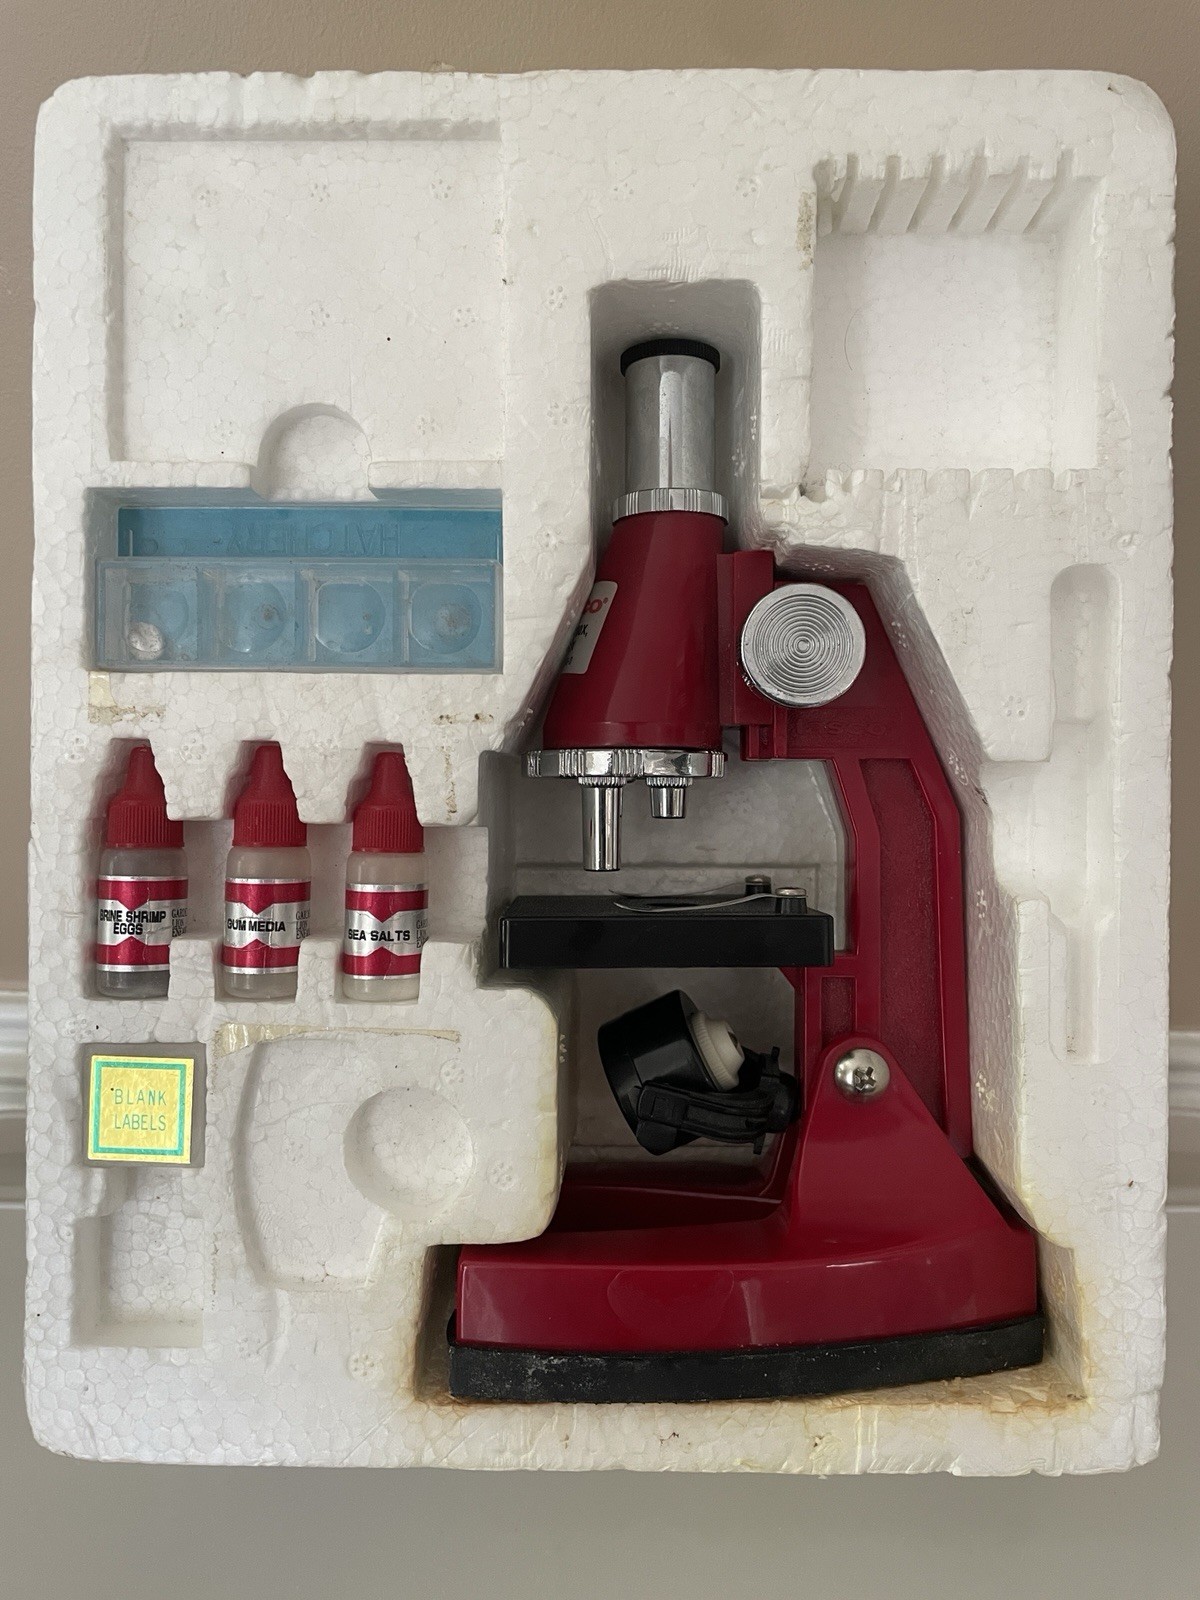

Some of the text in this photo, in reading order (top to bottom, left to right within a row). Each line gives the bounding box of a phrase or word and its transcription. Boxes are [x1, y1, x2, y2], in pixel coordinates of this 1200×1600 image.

[100, 909, 166, 923] BRINE SHRIMP
[113, 922, 143, 935] EGGS
[227, 918, 247, 931] GUM
[249, 920, 286, 932] MEDIA
[348, 928, 366, 941] SEA
[370, 930, 410, 942] SALTS
[114, 1088, 167, 1106] BLANK
[114, 1113, 167, 1131] LABELS
